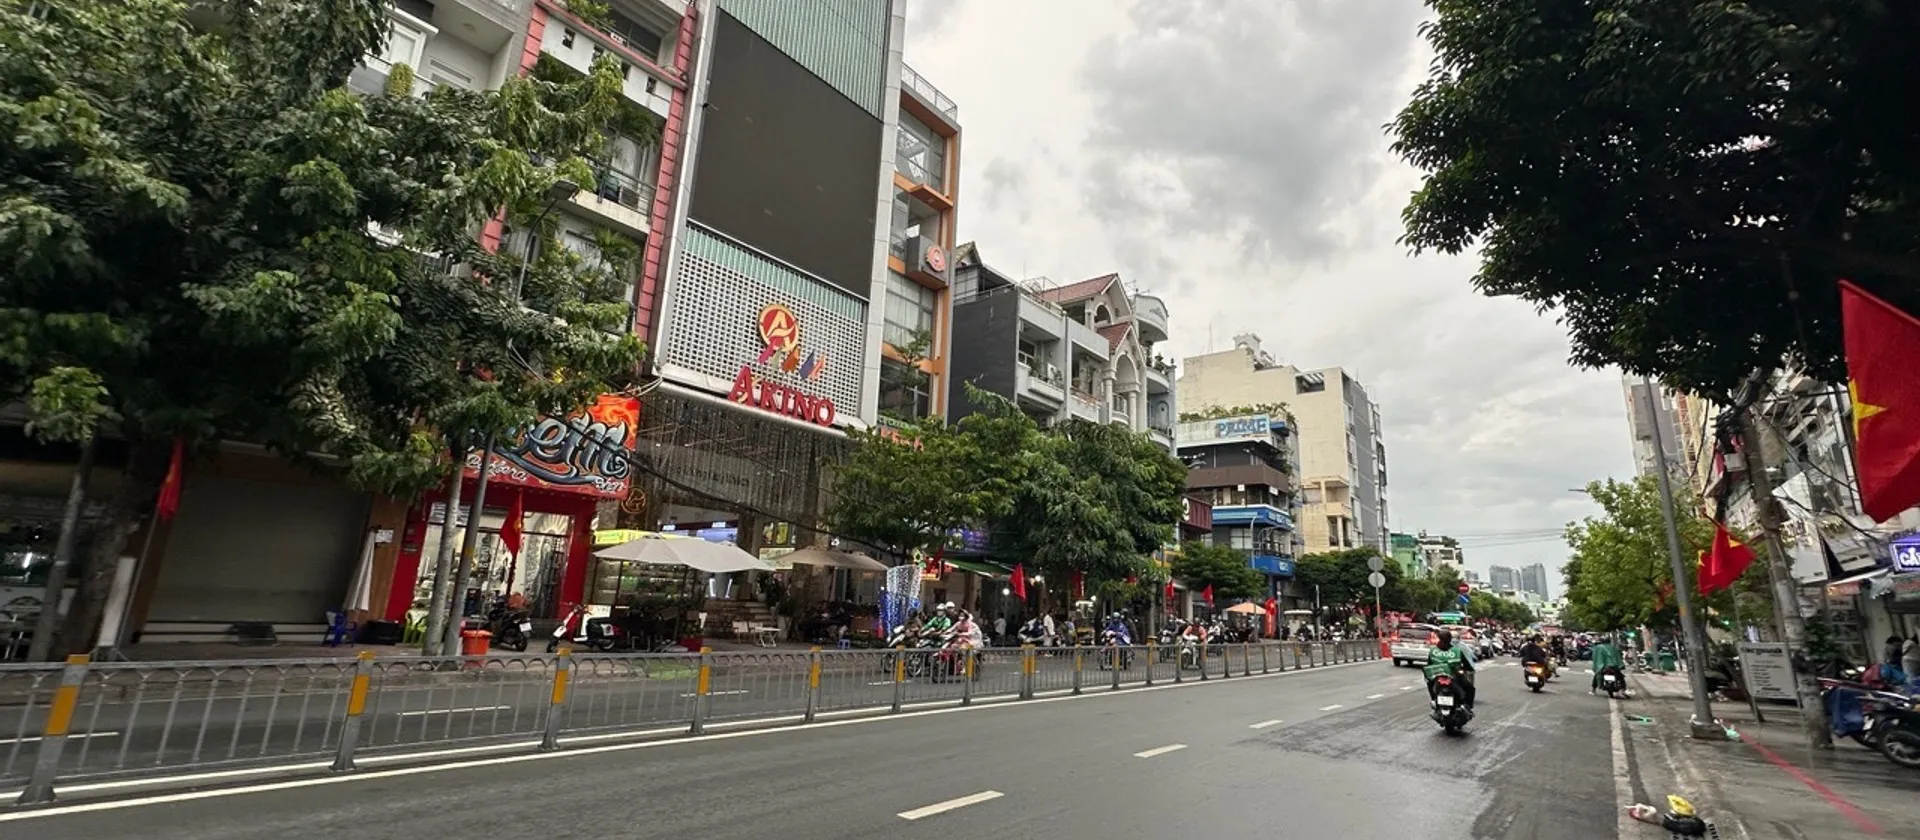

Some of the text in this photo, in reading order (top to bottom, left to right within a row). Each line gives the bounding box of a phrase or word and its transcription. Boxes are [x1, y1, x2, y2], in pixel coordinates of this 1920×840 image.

[728, 365, 835, 427] AKINO
[1215, 418, 1270, 438] PRIME
[1432, 649, 1456, 658] Grab
